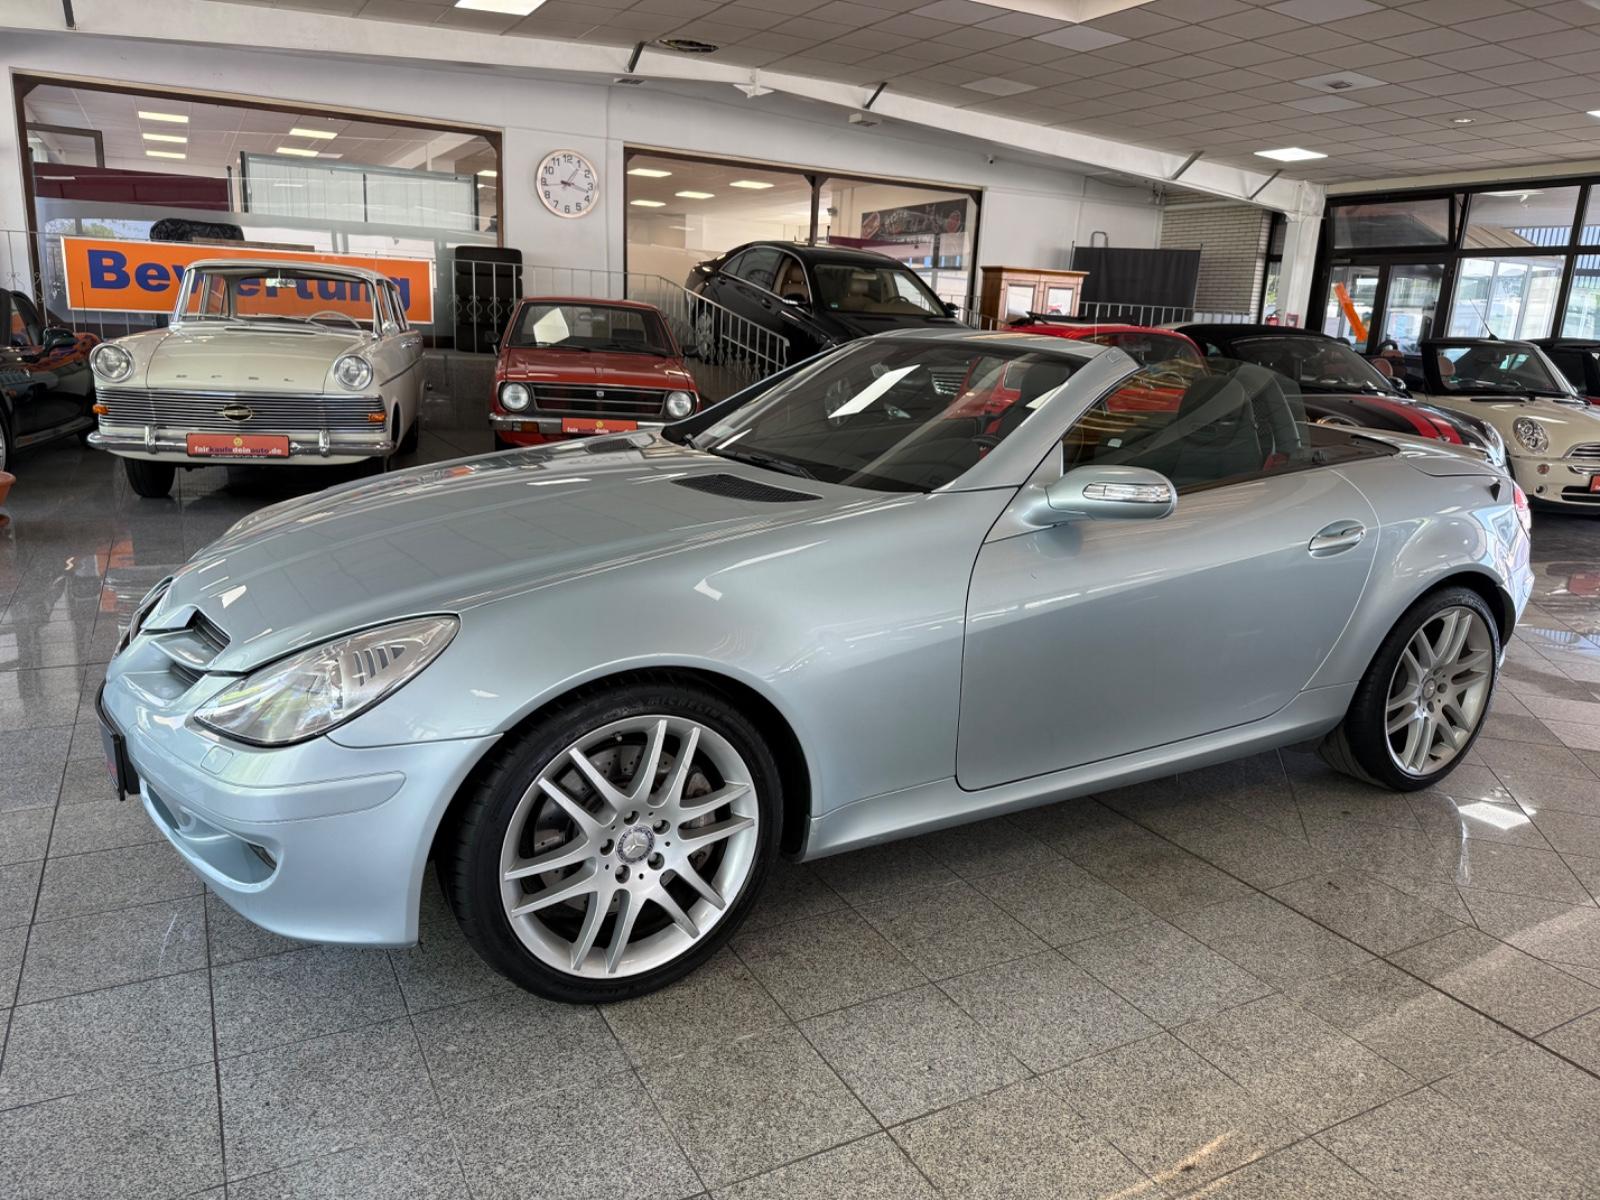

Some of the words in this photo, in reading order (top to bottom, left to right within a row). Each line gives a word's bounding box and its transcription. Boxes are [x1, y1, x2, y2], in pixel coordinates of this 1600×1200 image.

[551, 157, 560, 166] 11
[563, 154, 573, 164] 12
[544, 165, 554, 175] 10
